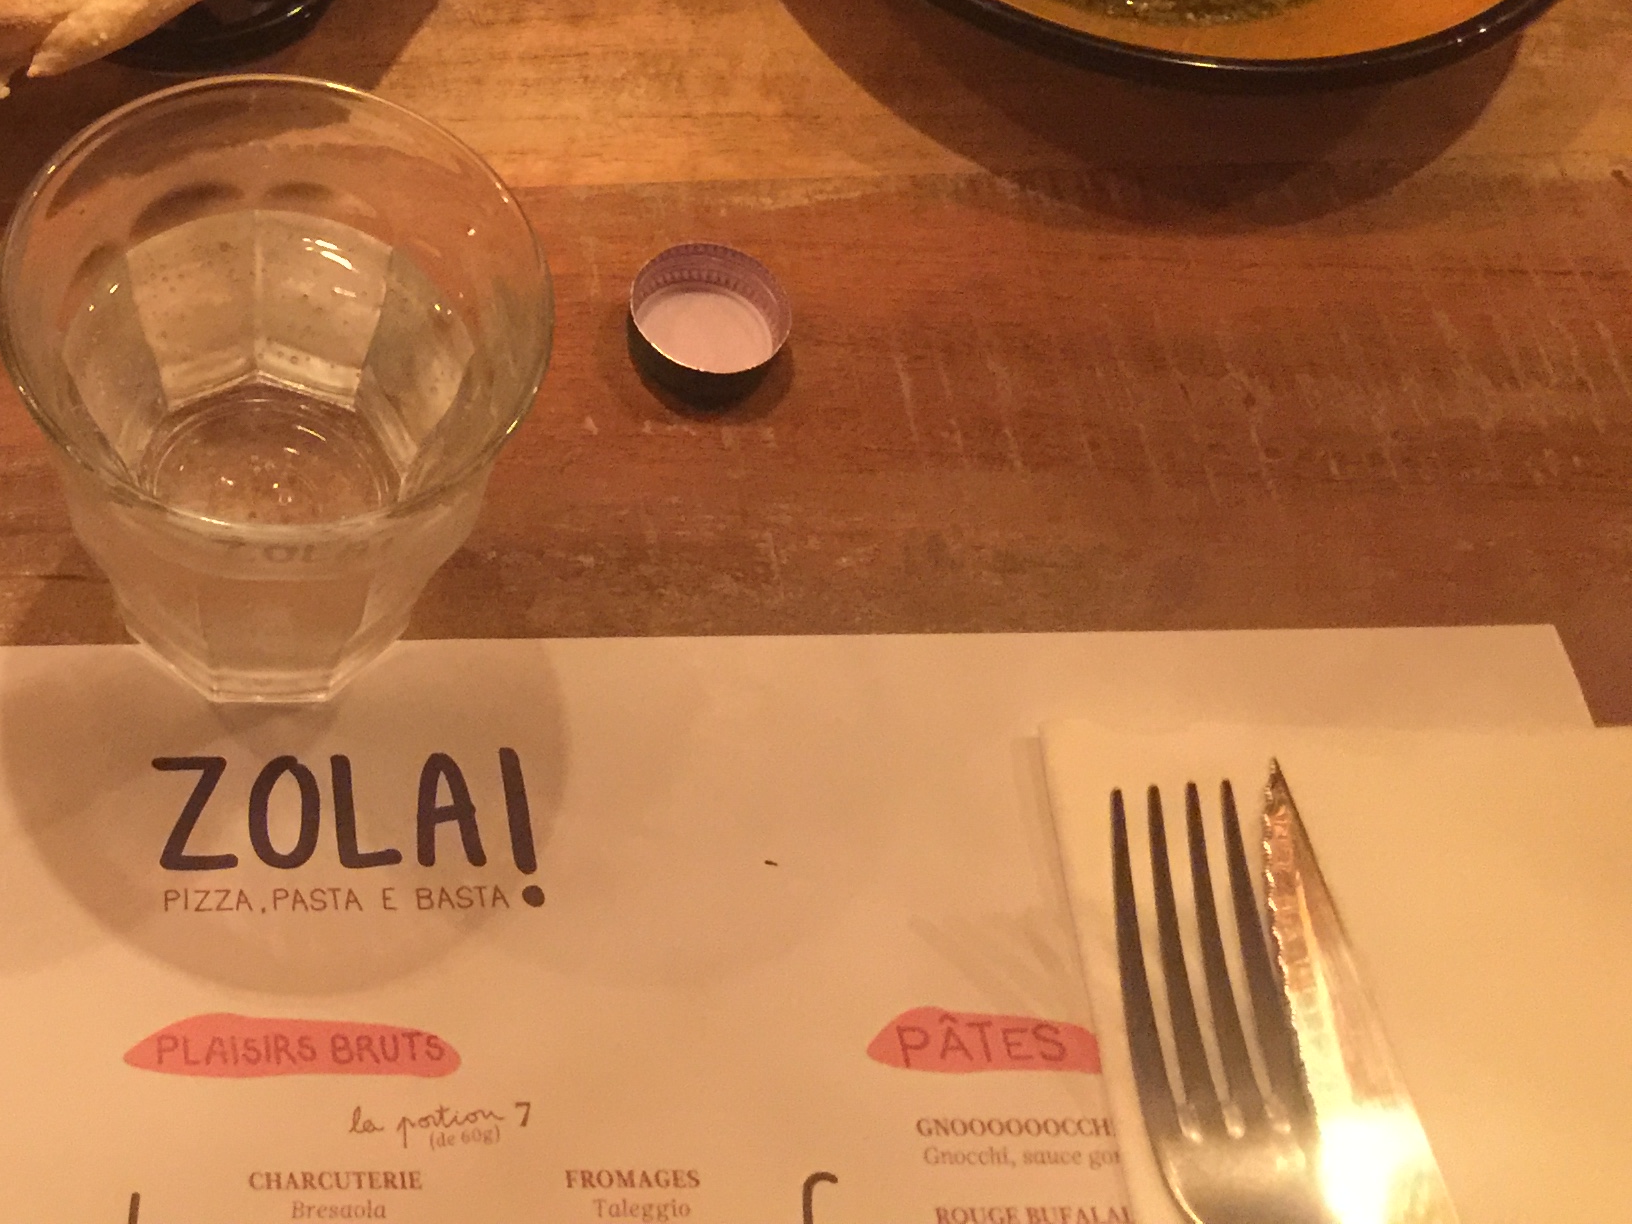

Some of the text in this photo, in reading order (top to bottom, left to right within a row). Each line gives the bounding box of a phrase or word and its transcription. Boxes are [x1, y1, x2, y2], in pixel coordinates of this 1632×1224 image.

[151, 746, 548, 910] ZOLA!
[381, 887, 399, 912] E
[415, 885, 511, 911] BASTA
[155, 1030, 446, 1066] PLAISIRS BRUTS
[895, 1012, 1066, 1068] PÂTES
[348, 1101, 532, 1149] la portion 7
[429, 1130, 456, 1151] (de
[923, 1145, 1017, 1169] Gnocchi,
[1022, 1149, 1083, 1166] sauce
[248, 1170, 424, 1191] CHARCUTERIE
[564, 1169, 701, 1190] FROMAGES
[291, 1199, 388, 1220] Bresaola
[593, 1198, 692, 1221] Taleggio
